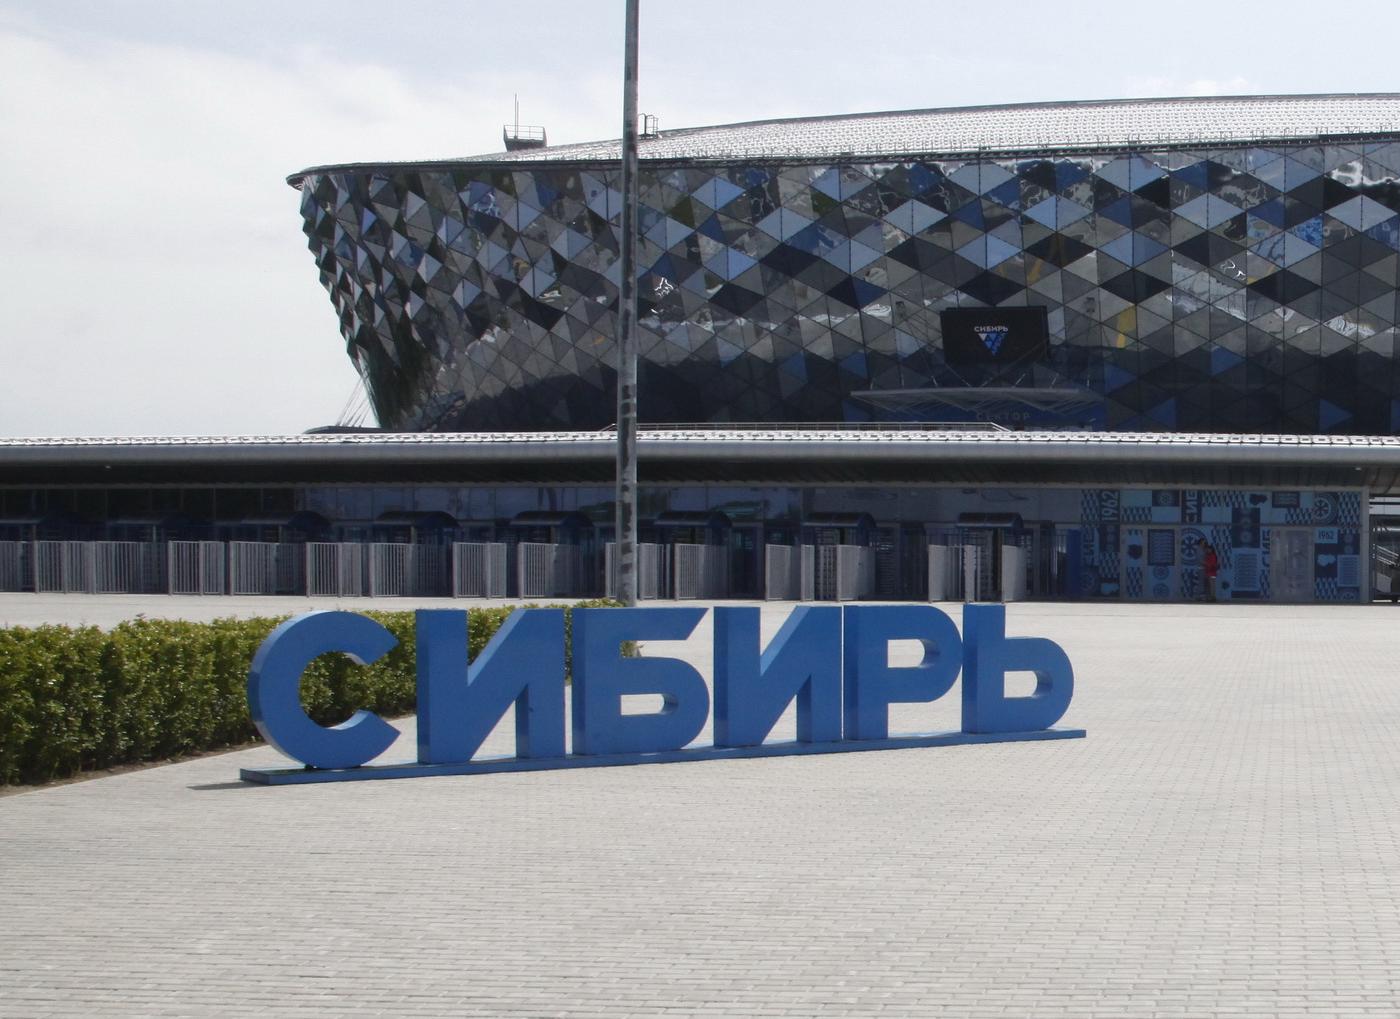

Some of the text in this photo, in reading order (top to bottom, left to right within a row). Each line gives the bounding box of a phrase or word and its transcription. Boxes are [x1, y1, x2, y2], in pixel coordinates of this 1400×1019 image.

[1101, 491, 1119, 521] 1962
[1318, 530, 1334, 540] 1962
[247, 604, 1075, 768] СИБИРЬ
